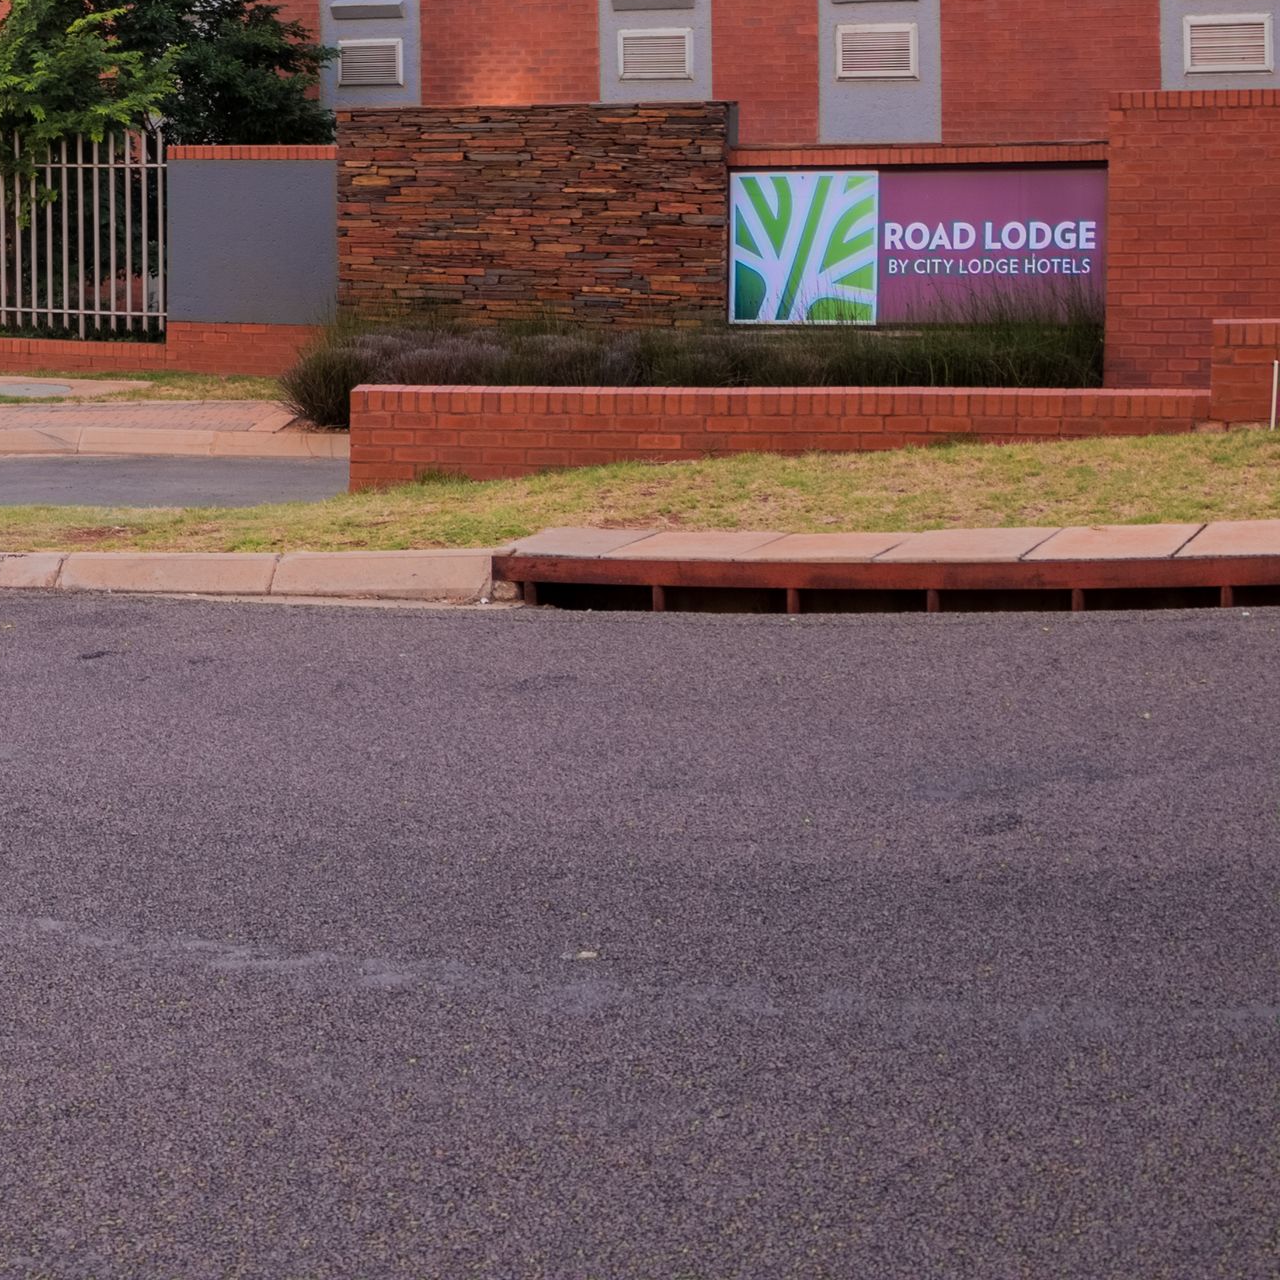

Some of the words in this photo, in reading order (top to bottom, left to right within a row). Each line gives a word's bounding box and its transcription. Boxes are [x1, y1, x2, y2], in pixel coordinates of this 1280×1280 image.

[884, 222, 976, 250] ROAD
[985, 221, 1096, 250] LODGE
[888, 259, 909, 274] BY
[914, 259, 954, 274] CITY
[959, 259, 1019, 274] LODGE
[1024, 258, 1090, 274] HOTELS
